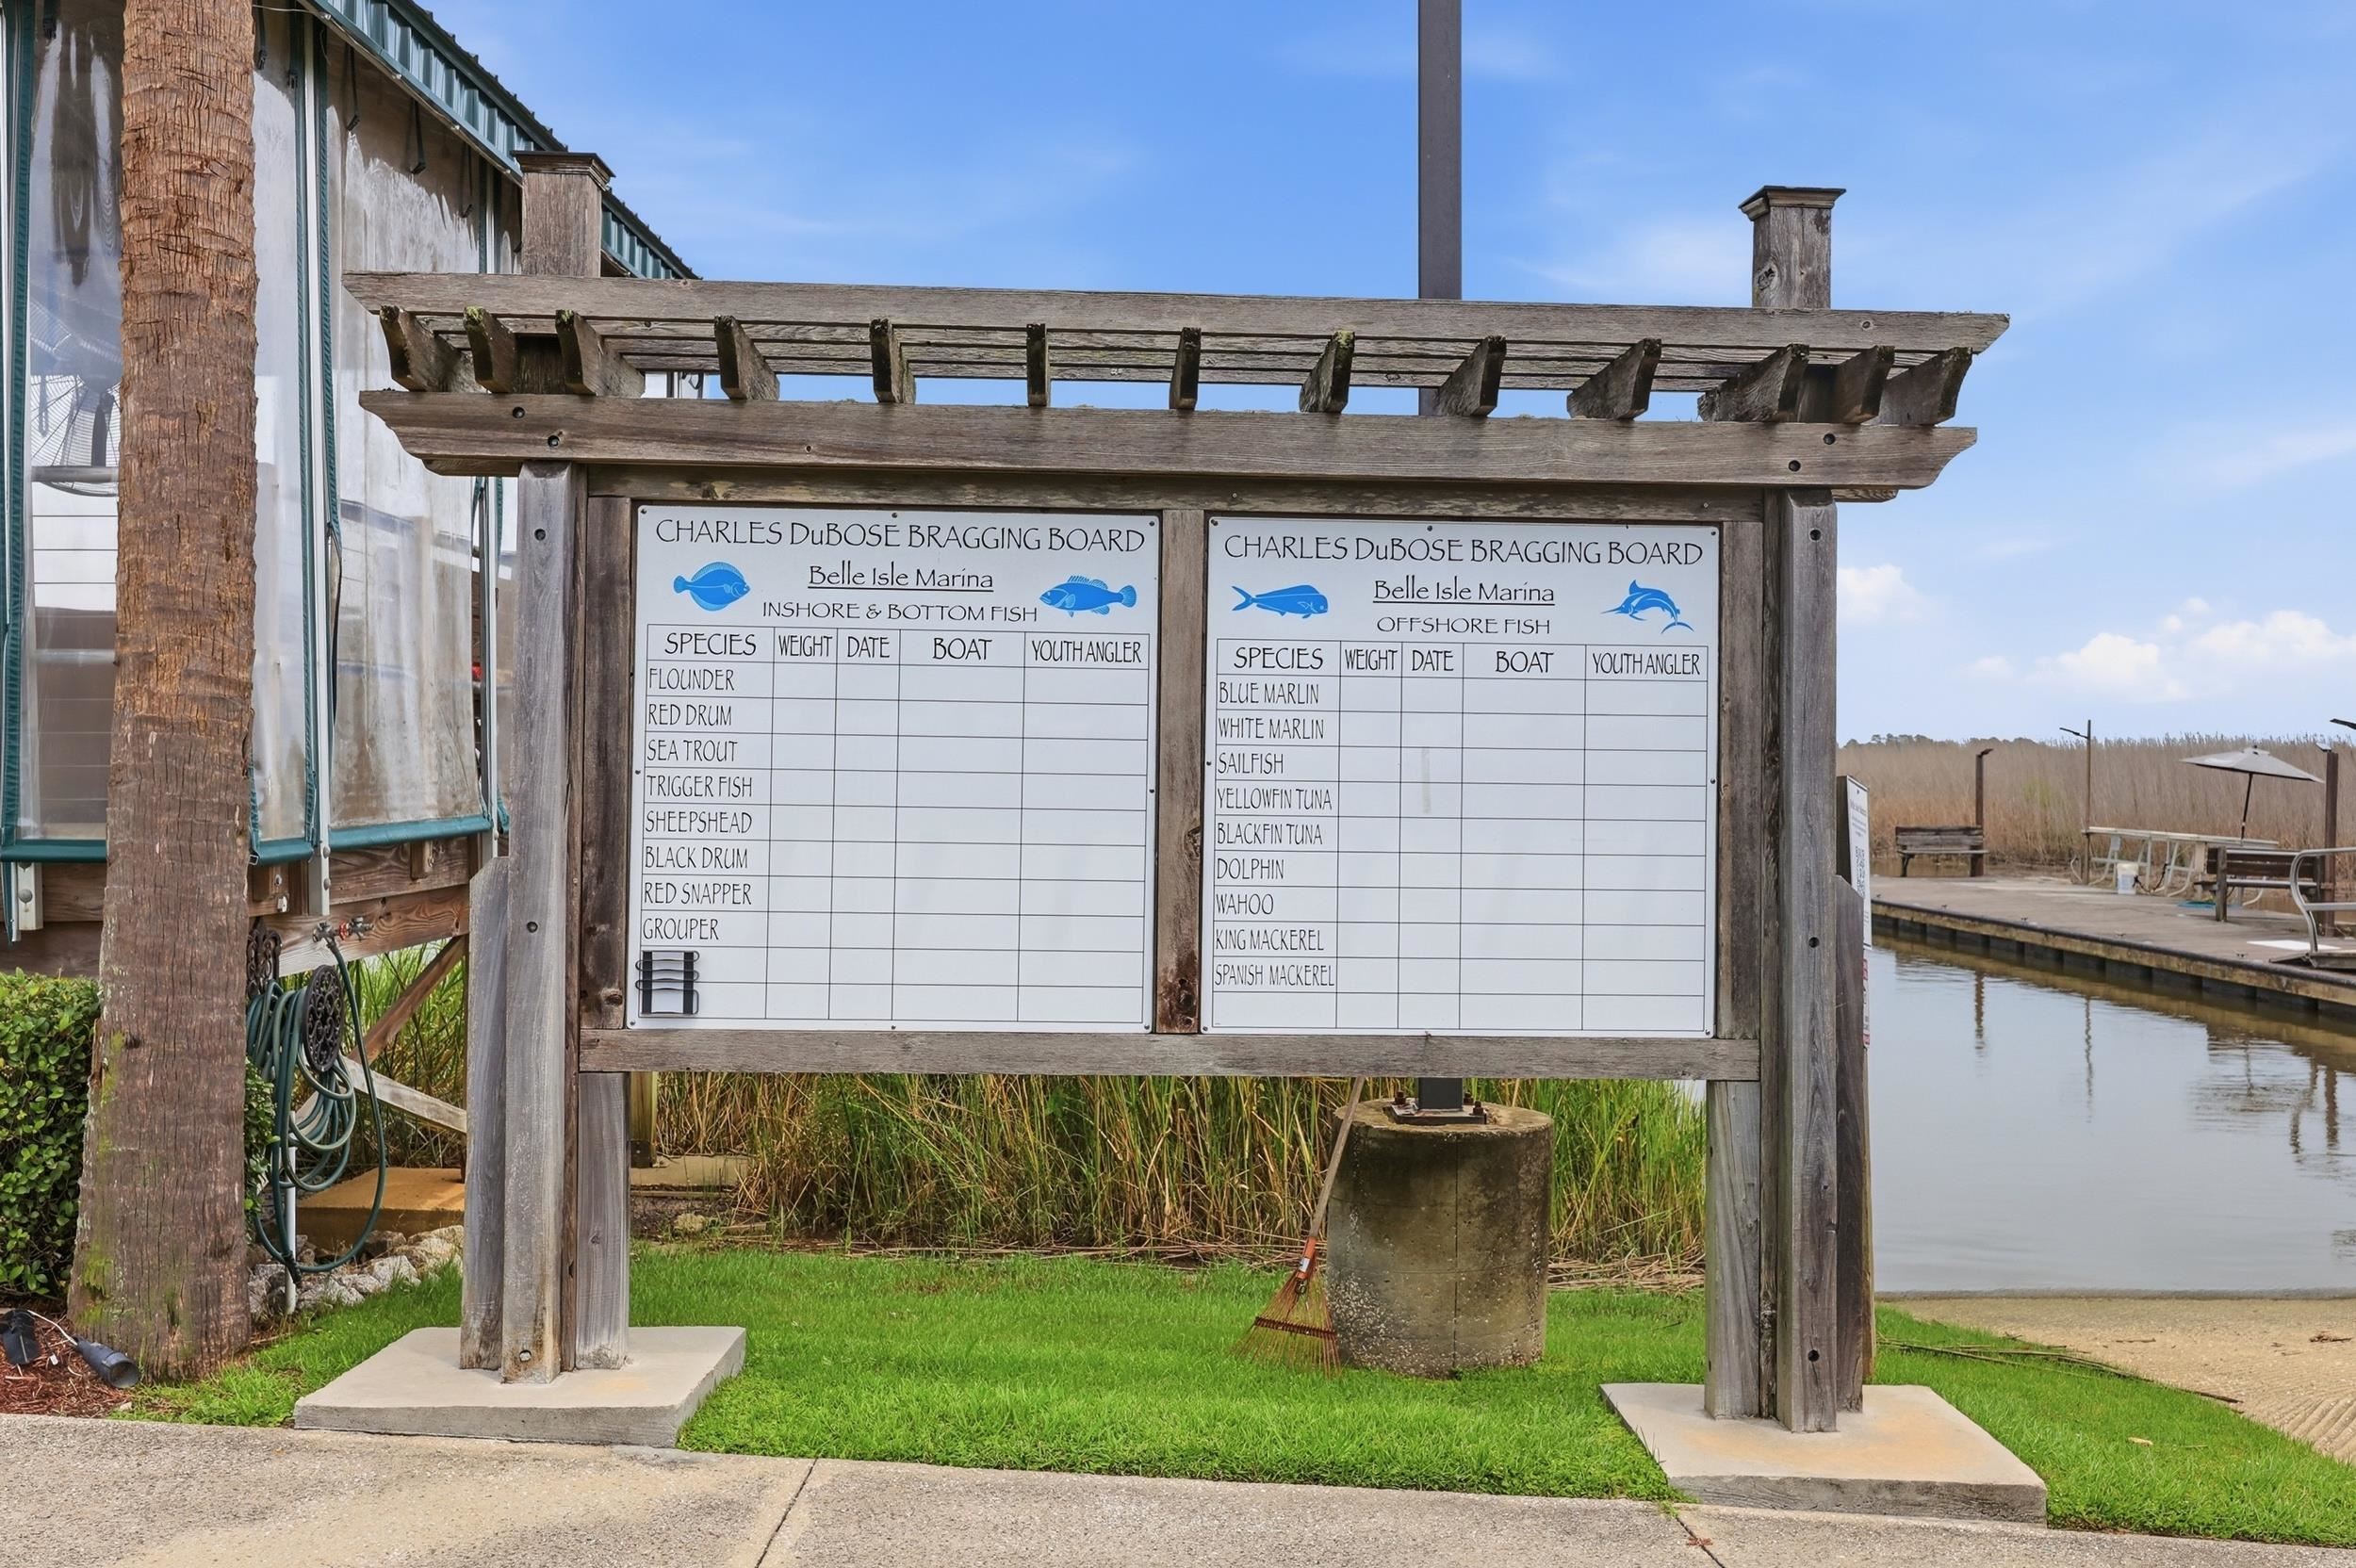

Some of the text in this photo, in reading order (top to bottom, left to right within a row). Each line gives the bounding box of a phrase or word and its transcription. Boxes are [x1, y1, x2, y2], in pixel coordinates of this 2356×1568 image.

[656, 519, 1144, 552] CHARLES DuBOSE BRAGGING BOARD
[1225, 535, 1703, 564] CHARLES DuBOSE BRAGGING BOARD
[810, 560, 993, 588] Belle Isle Marina
[1374, 575, 1555, 602] Belle Isle Marina
[763, 602, 1037, 622] INSHORE & BOTTOM FISH
[1377, 617, 1549, 634] OFFSHORE FISH
[664, 633, 756, 656] SPECIES
[778, 635, 832, 657] WEIGHT
[847, 636, 890, 658] DATE
[933, 638, 992, 660] BOAT
[1234, 647, 1323, 669] SPECIES
[1345, 649, 1398, 670] WEIGHT
[1412, 650, 1453, 671] DATE
[1496, 651, 1554, 673] BOAT
[649, 668, 734, 691] FLOUNDER
[1219, 682, 1318, 704] BLUE MARLIN
[648, 704, 731, 726] RED DRUM
[1218, 717, 1323, 739] WHITE MARLIN
[647, 740, 738, 761] SEA TROUT
[1218, 753, 1284, 774] SAILFISH
[646, 776, 752, 797] TRIGGER FISH
[1218, 788, 1332, 809] YELLOWFIN TUNA
[646, 810, 752, 833] SHEEPSHEAD
[1218, 823, 1322, 844] BLACKFIN TUNA
[645, 846, 747, 869] BLACK DRUM
[1218, 858, 1284, 879] DOLPHIN
[645, 882, 751, 905] RED SNAPPER
[1216, 893, 1274, 914] WAHOO
[643, 918, 718, 939] GROUPER
[1217, 929, 1324, 950] KING MACKEREL
[1215, 964, 1334, 986] SPANISH MACKEREL
